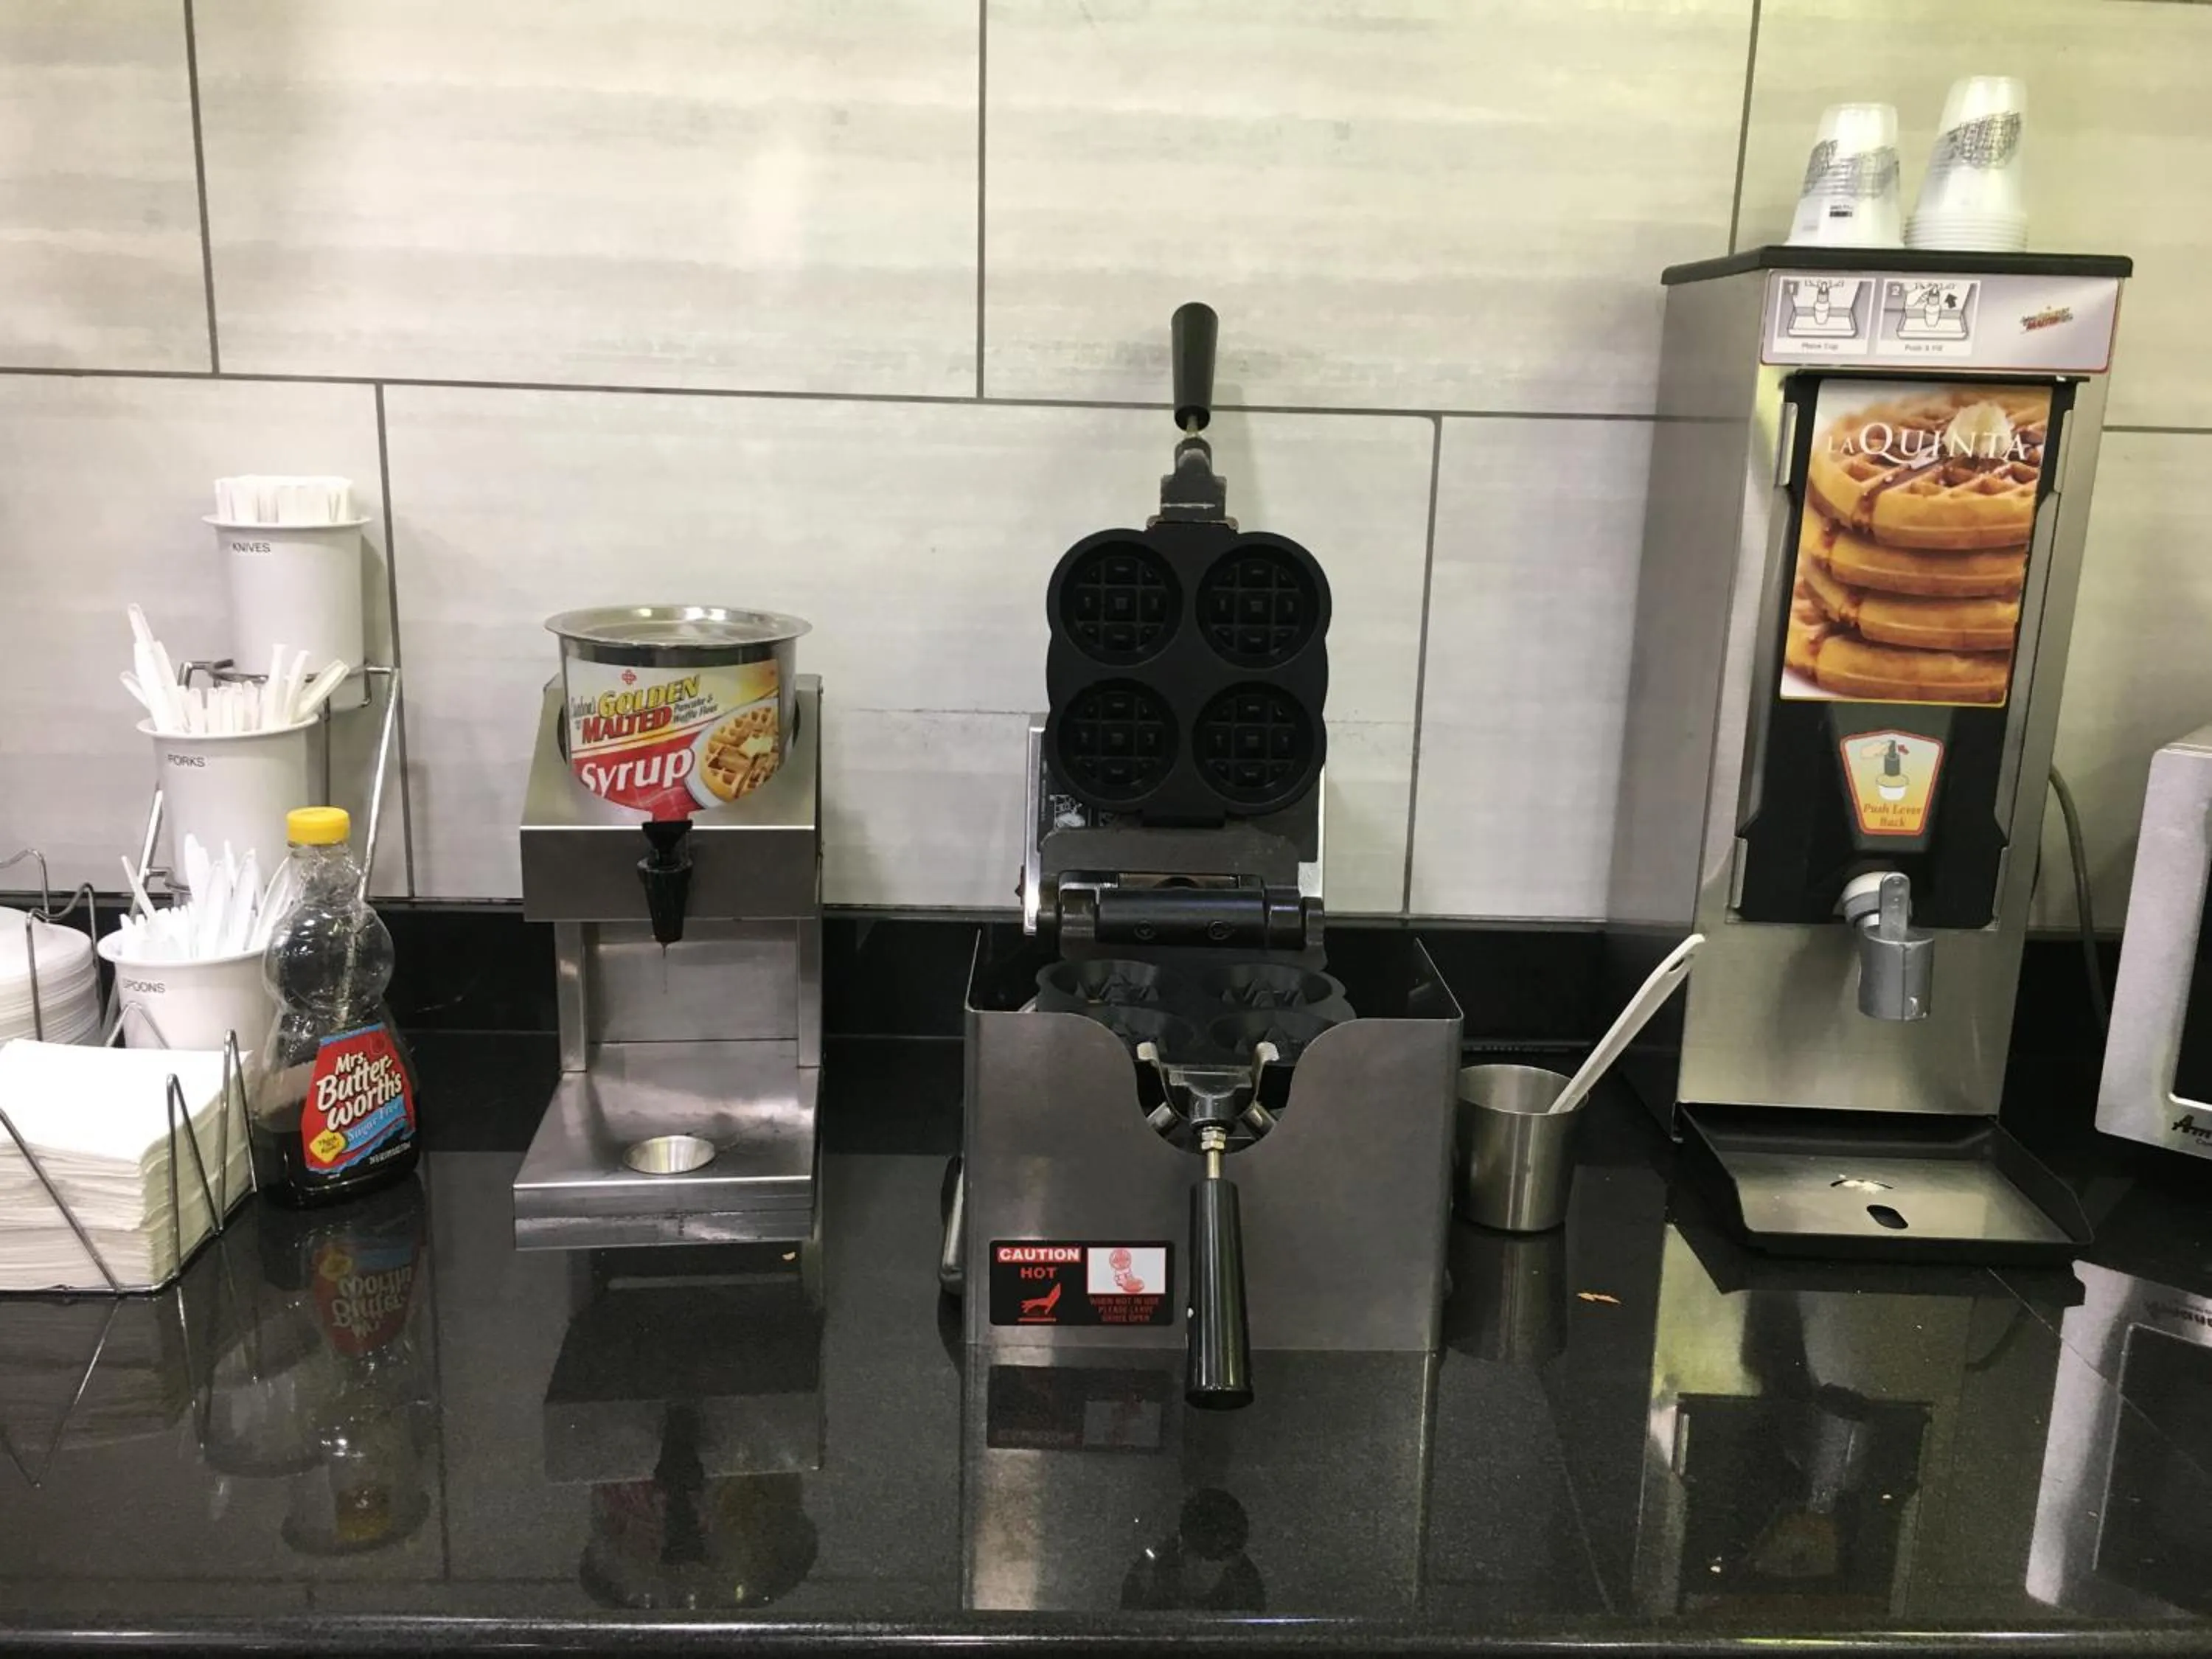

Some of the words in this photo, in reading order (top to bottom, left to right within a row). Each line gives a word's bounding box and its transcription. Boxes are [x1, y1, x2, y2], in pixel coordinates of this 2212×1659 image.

[1828, 436, 1854, 453] LA
[1859, 422, 2028, 464] QUINTA
[232, 542, 271, 553] KNIVES
[598, 674, 700, 719] GOLDEN
[582, 706, 673, 745] MALTED
[167, 754, 206, 768] FORKS
[1864, 804, 1890, 813] Push
[1893, 804, 1921, 815] Lever
[999, 1248, 1080, 1261] CAUTION
[1020, 1267, 1057, 1279] HOT
